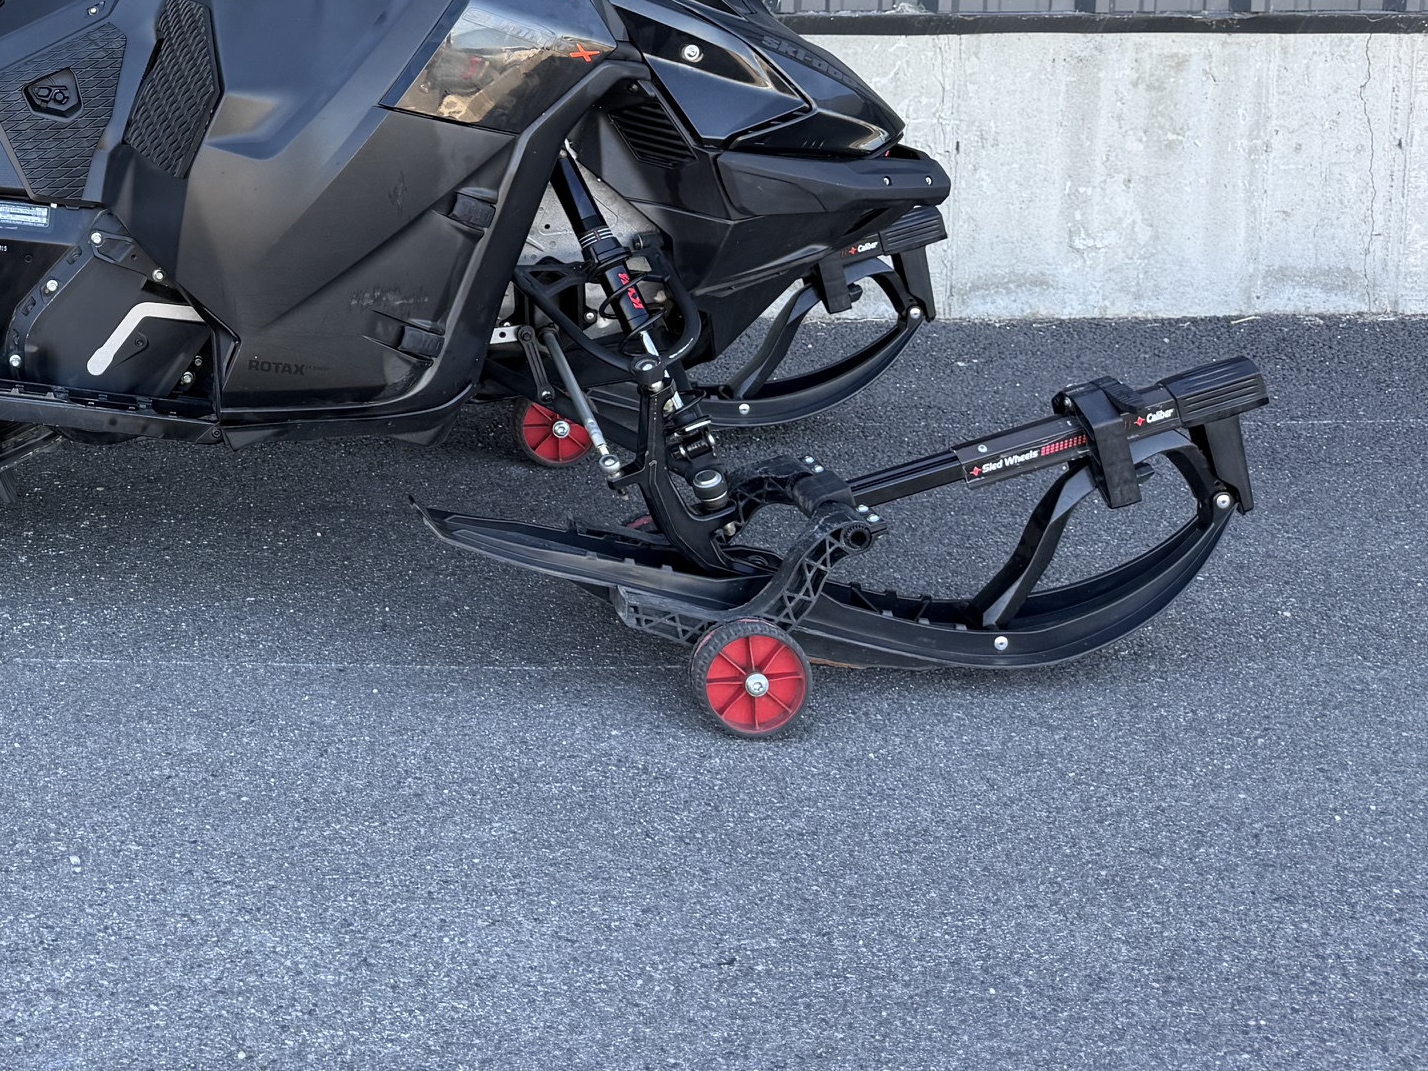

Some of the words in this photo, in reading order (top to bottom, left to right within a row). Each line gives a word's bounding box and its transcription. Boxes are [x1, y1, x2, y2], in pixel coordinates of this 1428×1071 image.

[248, 359, 305, 375] ROTAX
[1146, 408, 1175, 424] Caliber
[981, 458, 1004, 474] Sled
[1004, 449, 1040, 468] Wheels
